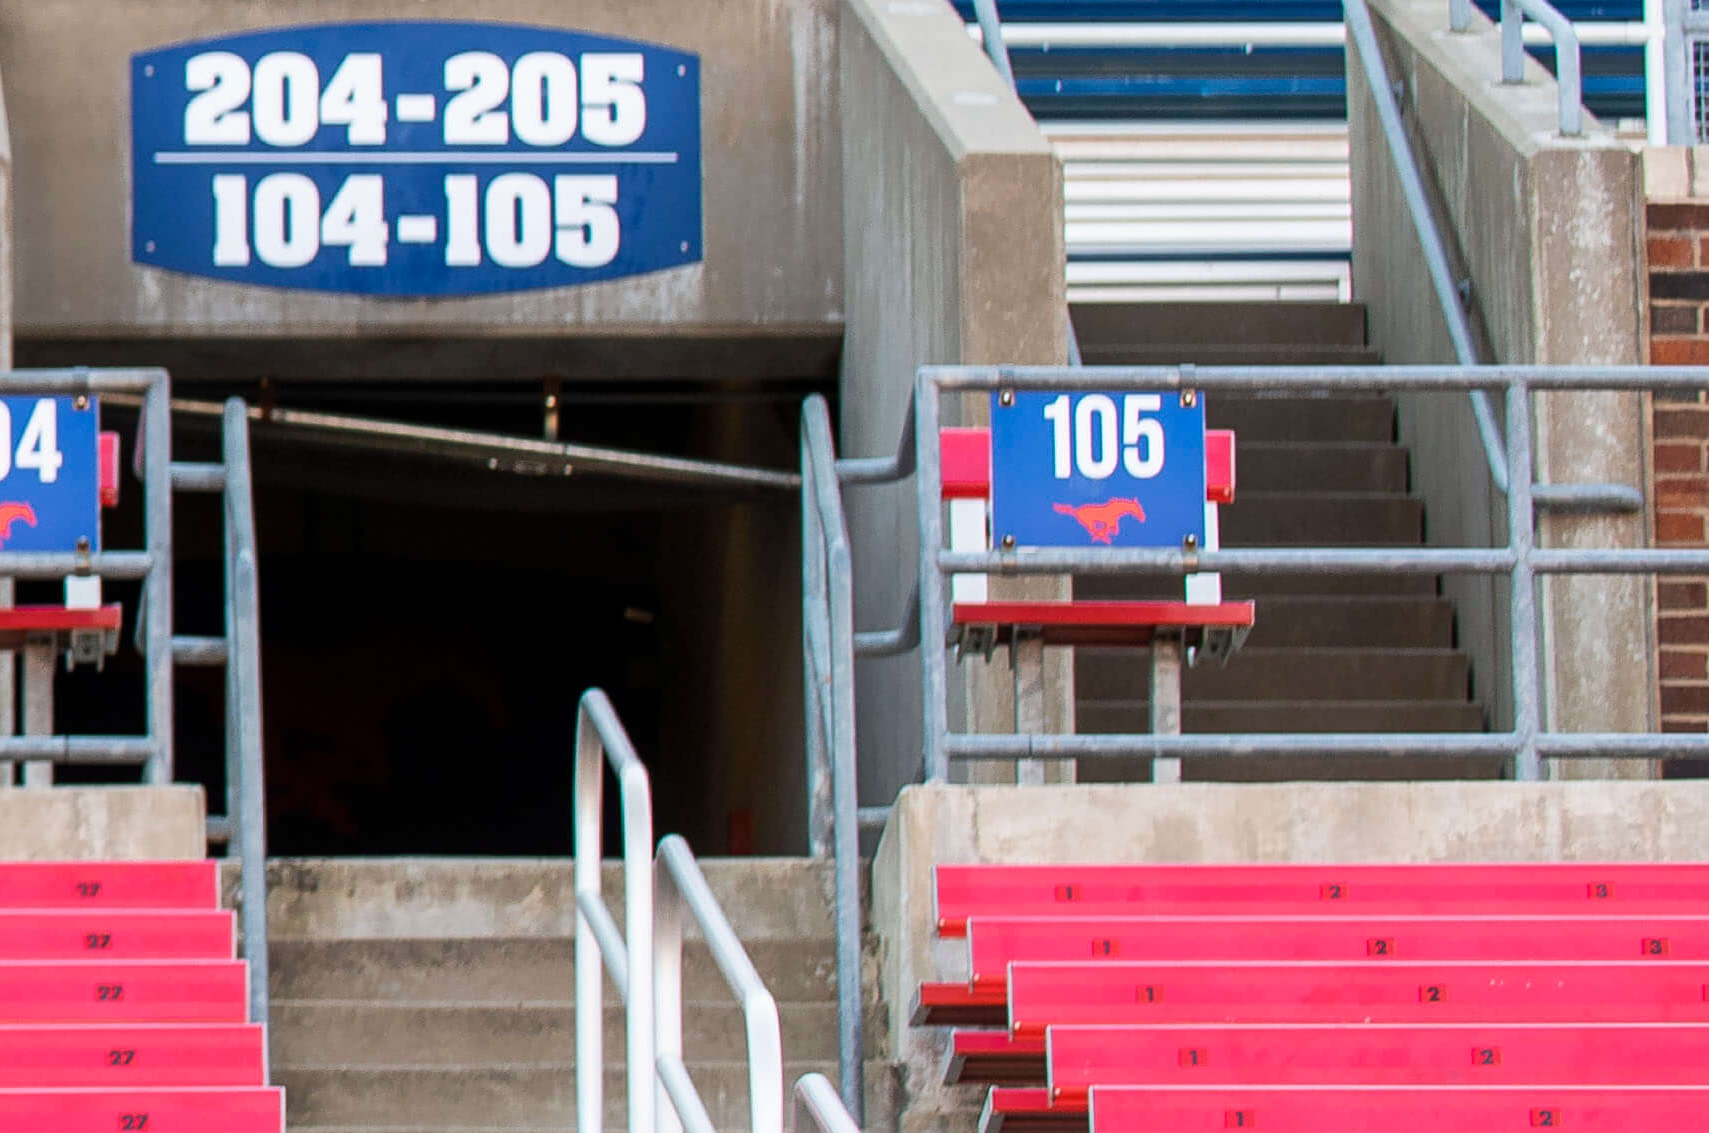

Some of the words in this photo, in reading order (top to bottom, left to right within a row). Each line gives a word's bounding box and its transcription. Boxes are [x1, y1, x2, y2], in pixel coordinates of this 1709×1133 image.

[185, 52, 646, 146] 204-205
[213, 173, 620, 268] 104-105
[1043, 394, 1165, 479] 105
[1329, 885, 1340, 899] 2
[1597, 884, 1607, 898] 3
[1375, 940, 1387, 955] 2
[1650, 940, 1662, 955] 3
[1427, 987, 1440, 1002] 2
[1481, 1049, 1494, 1064] 2
[1540, 1110, 1553, 1126] 2
